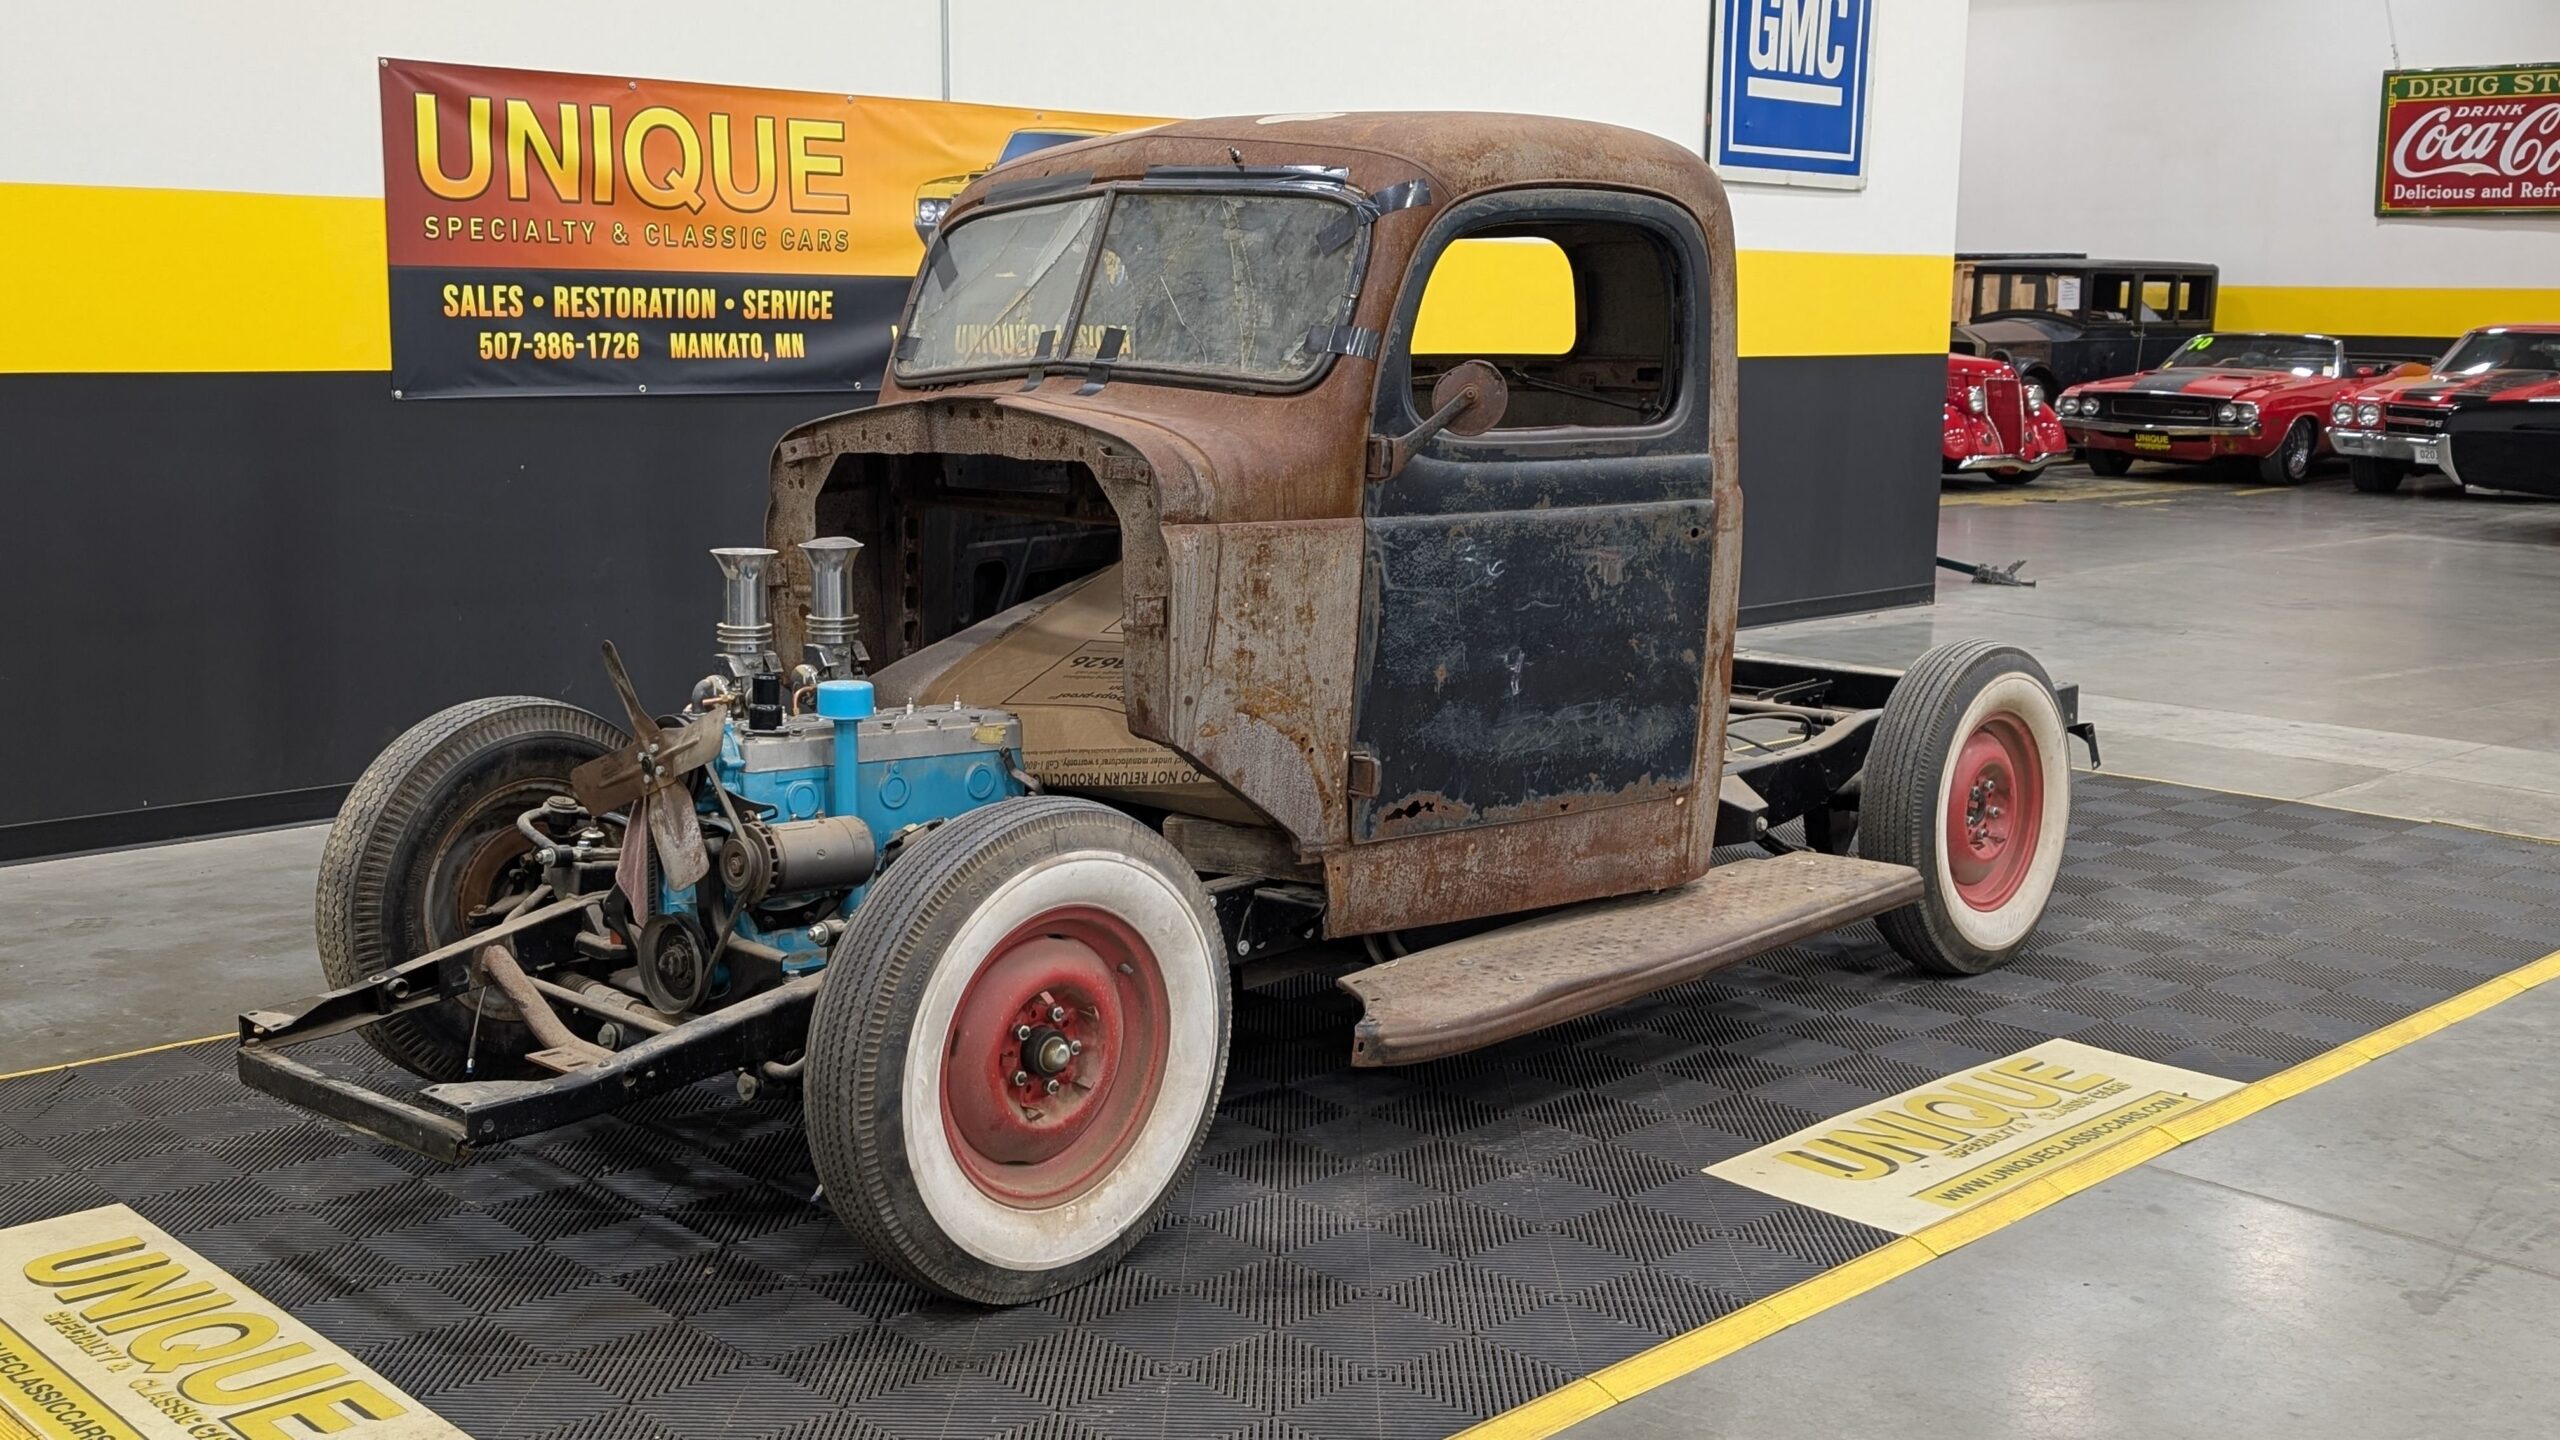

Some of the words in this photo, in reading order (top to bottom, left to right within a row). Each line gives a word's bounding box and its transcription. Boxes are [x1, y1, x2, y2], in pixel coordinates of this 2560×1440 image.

[1749, 0, 1848, 79] GMC
[2407, 76, 2499, 97] DRUG
[2513, 73, 2560, 93] ST
[2454, 104, 2527, 118] DRINK
[414, 92, 850, 215] UNIQUE
[2393, 184, 2475, 200] Delicious
[2481, 183, 2513, 199] and
[424, 215, 596, 243] SPECIALTY
[612, 222, 630, 244] &
[644, 223, 767, 249] CLASSIC
[781, 228, 850, 252] CARS
[443, 284, 524, 318] SALES
[554, 286, 716, 319] RESTORATION
[743, 289, 834, 320] SERVICE
[480, 332, 640, 360] 507-386-1726
[670, 332, 770, 362] MANKATO,
[775, 333, 805, 358] MN
[2187, 336, 2214, 351] 70
[2135, 433, 2169, 444] UNIQUE
[1045, 759, 1059, 770] Call
[1094, 756, 1149, 769] manufacturer's
[1151, 757, 1173, 768] under
[1049, 772, 1100, 786] PRODUCT
[1104, 771, 1148, 785] RETURN
[1151, 770, 1178, 784] NOT
[1181, 770, 1201, 783] DO
[1775, 1056, 2115, 1180] UNIQUE
[1936, 1096, 2185, 1201] WWW.UNIQUECLASSICCARS.COM
[23, 1236, 409, 1440] UNIQUE
[43, 1310, 128, 1363] SPECIALTY
[129, 1377, 208, 1426] CLASSIC
